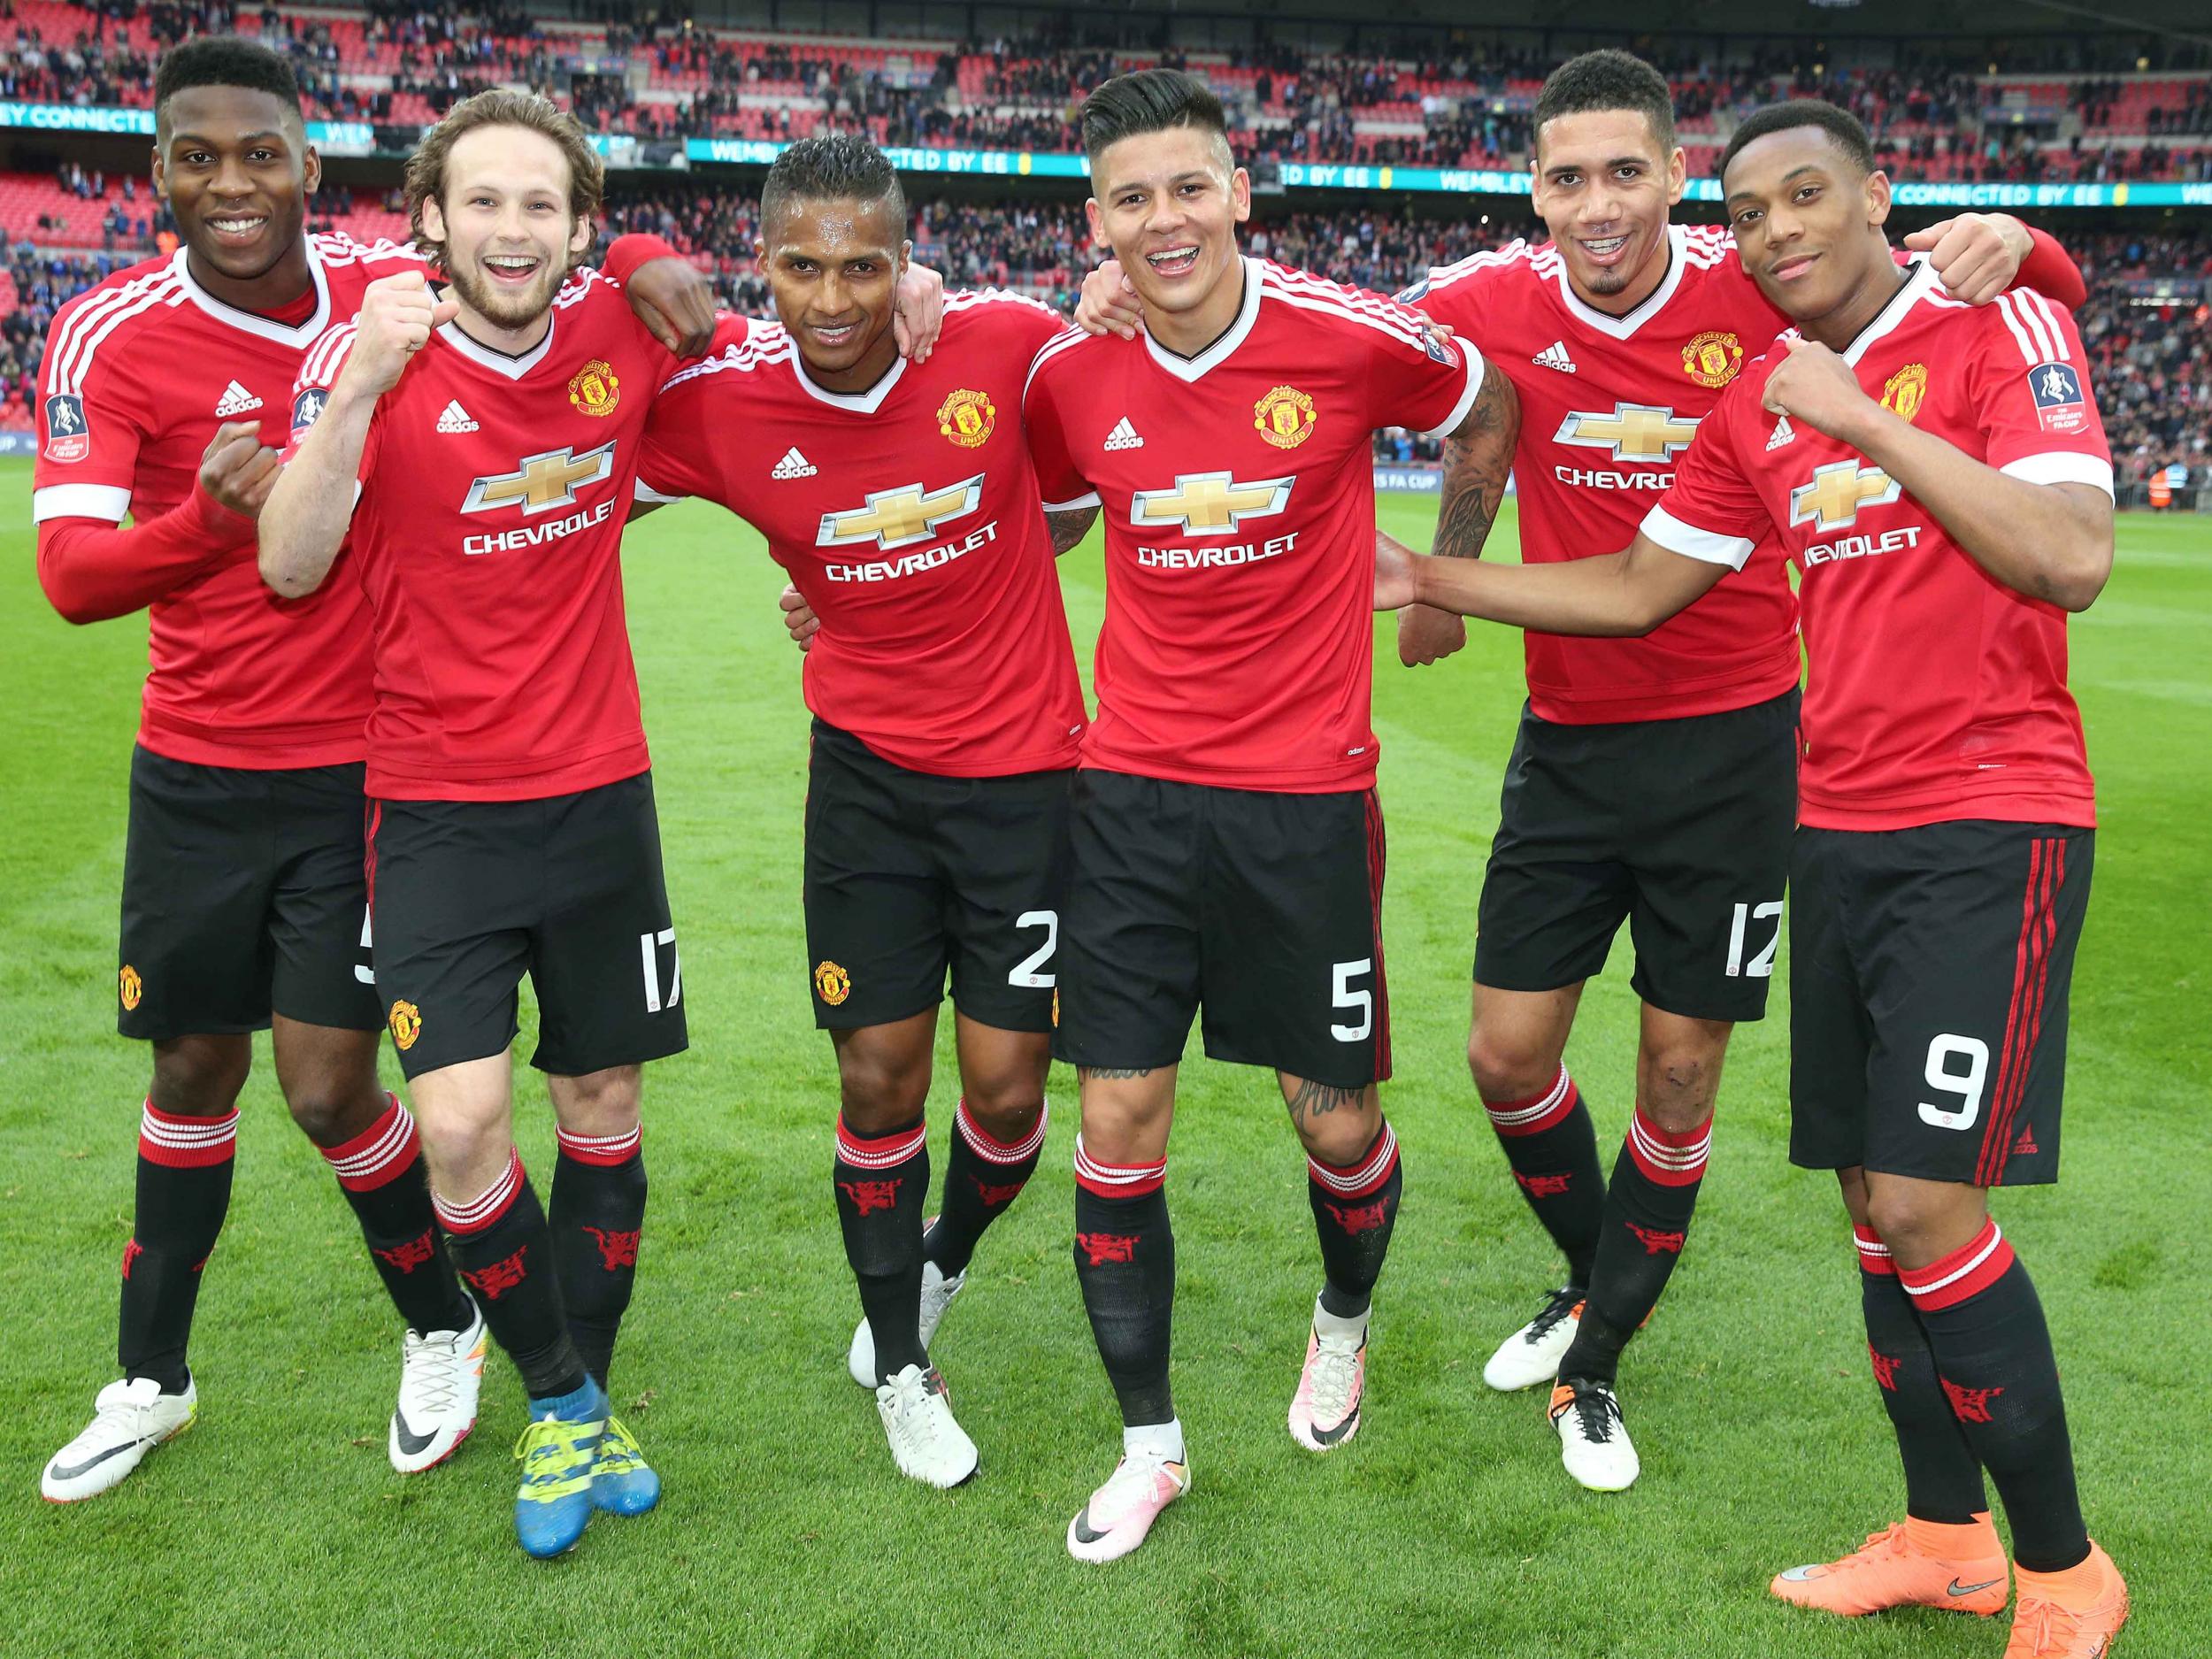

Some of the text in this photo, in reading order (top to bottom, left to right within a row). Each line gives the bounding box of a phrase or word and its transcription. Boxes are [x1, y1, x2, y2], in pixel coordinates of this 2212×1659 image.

[948, 151, 976, 173] BY
[981, 151, 1009, 173] EE
[1310, 165, 1338, 187] BY
[1343, 166, 1370, 188] EE
[1898, 183, 2032, 207] CONNECTED
[2037, 184, 2069, 206] BY
[2073, 184, 2102, 207] EE
[1688, 332, 1734, 357] MANCHESTER
[1532, 357, 1578, 374] adidas
[1702, 367, 1735, 384] UNITED
[215, 396, 265, 419] adidas
[588, 396, 617, 414] UNITED
[942, 391, 986, 421] MANCHESTER
[1259, 389, 1310, 414] MANCHESTER
[436, 420, 480, 434] adidas
[959, 426, 990, 444] UNITED
[1271, 431, 1307, 445] UNITED
[1103, 435, 1145, 452] adidas
[771, 464, 819, 480] adidas
[1408, 473, 1437, 489] CUP
[463, 495, 617, 556] CHEVROLET
[825, 520, 998, 582] CHEVROLET
[1137, 531, 1300, 569] CHEVROLET
[1008, 910, 1058, 988] 2
[1724, 900, 1785, 978] 12
[640, 926, 681, 1014] 17
[1330, 957, 1372, 1042] 5
[1916, 1033, 1990, 1132] 9
